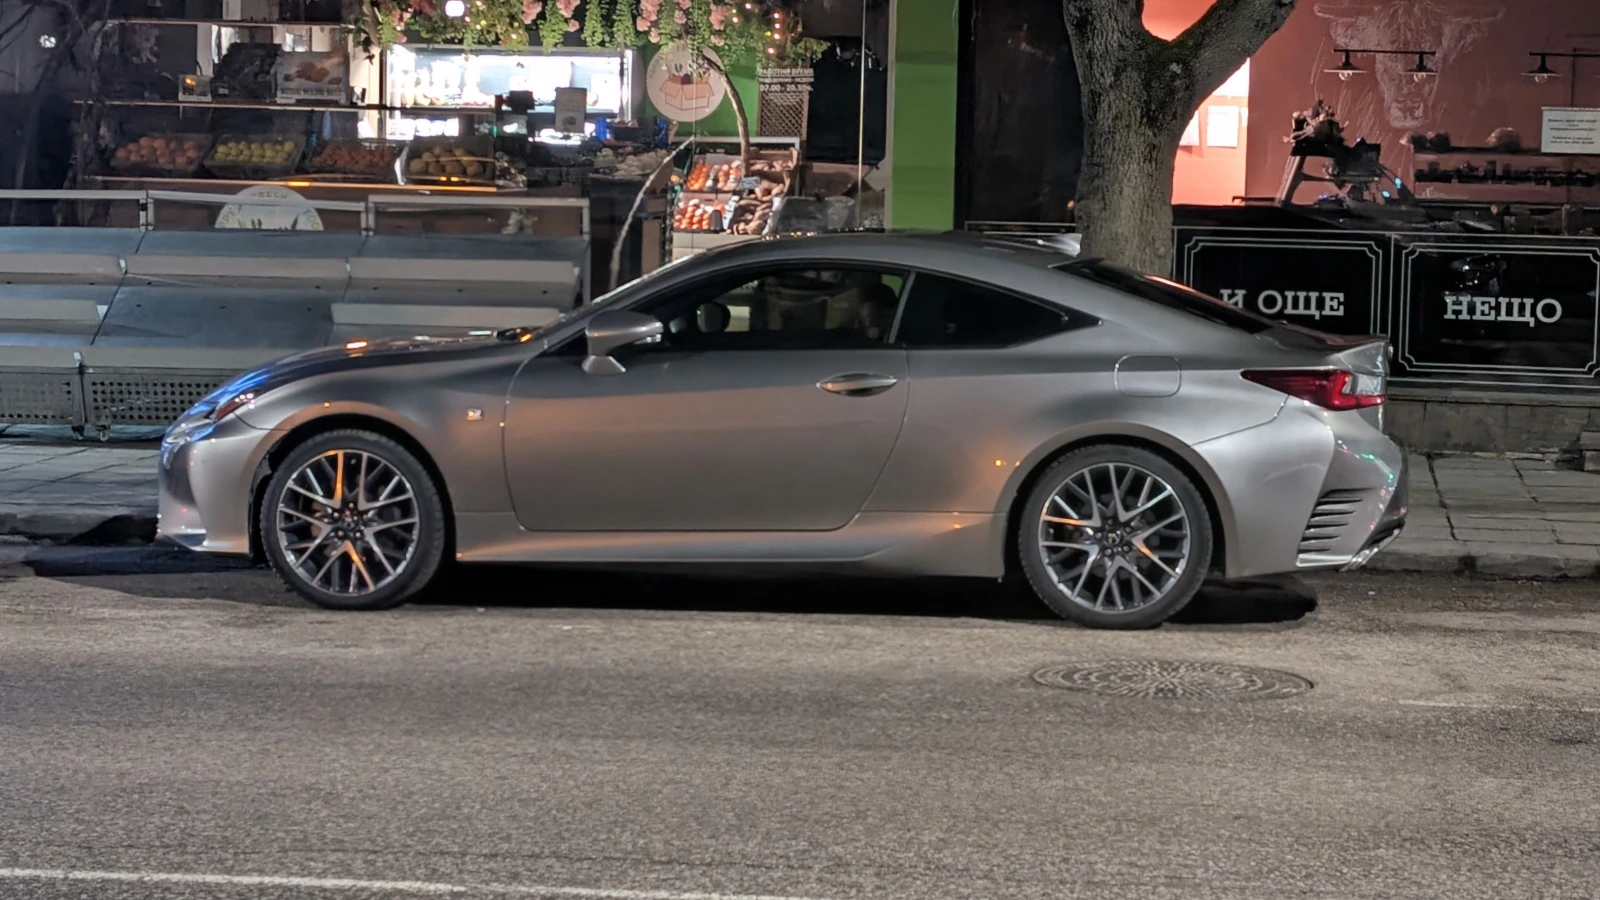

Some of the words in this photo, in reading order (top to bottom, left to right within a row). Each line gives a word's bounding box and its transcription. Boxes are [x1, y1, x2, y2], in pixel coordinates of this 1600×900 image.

[1220, 289, 1246, 308] И
[1257, 289, 1344, 320] ОЩЕ
[1443, 296, 1562, 327] НЕЩО
